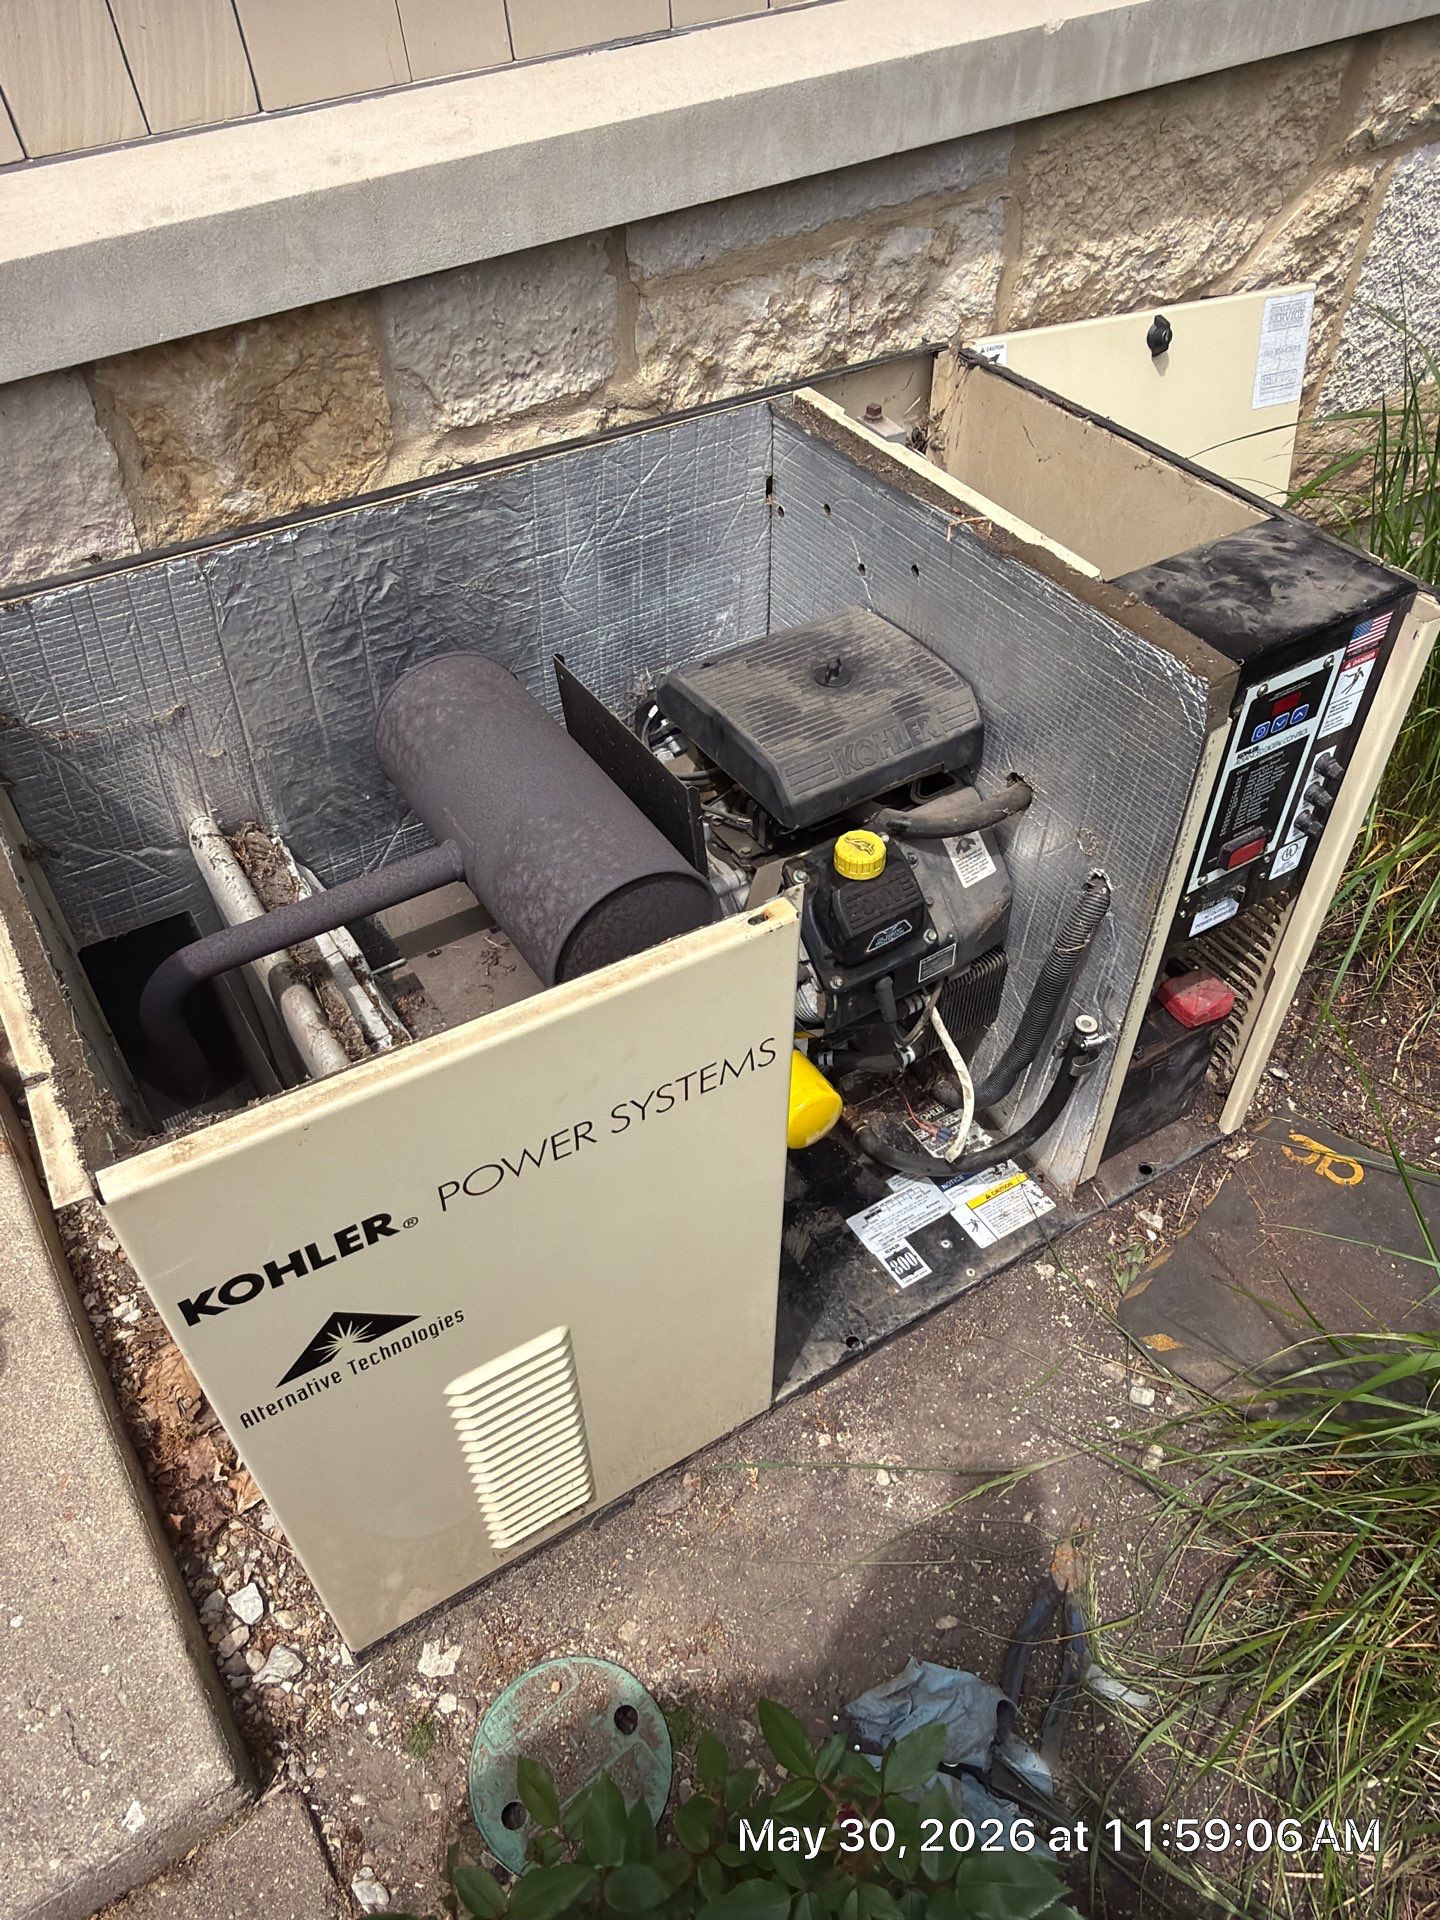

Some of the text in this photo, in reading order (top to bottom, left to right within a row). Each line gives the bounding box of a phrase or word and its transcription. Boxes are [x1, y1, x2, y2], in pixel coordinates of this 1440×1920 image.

[986, 344, 1005, 353] CAUTION
[1352, 651, 1376, 667] DANGER
[831, 713, 942, 776] KOHLER
[437, 1121, 597, 1212] POWER
[610, 1037, 776, 1133] SYSTEMS
[941, 1174, 965, 1190] NOTICE
[991, 1181, 1015, 1196] CAUTION
[889, 1251, 919, 1275] 800
[239, 1309, 465, 1430] Alternative Technologies
